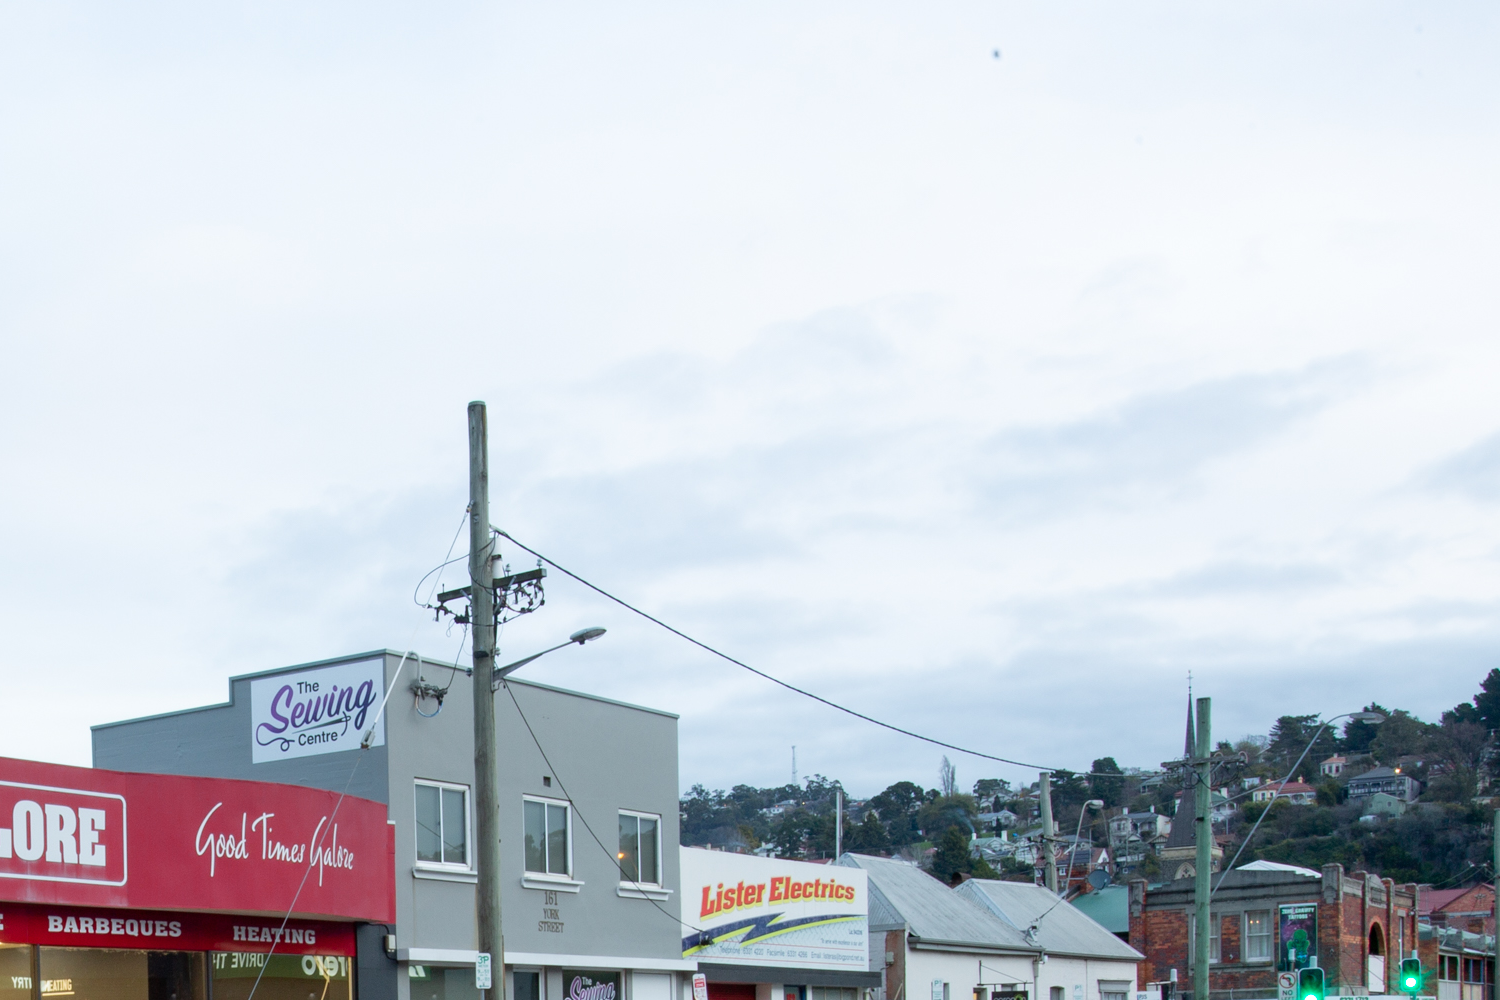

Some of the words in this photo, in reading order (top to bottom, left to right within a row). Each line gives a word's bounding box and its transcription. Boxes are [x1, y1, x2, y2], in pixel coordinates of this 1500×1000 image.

[297, 681, 319, 694] The
[257, 679, 376, 740] Sewing
[298, 731, 338, 746] Centre
[195, 802, 249, 877] Good
[252, 812, 306, 863] Times
[310, 816, 354, 887] Galore
[544, 891, 558, 905] 161
[700, 881, 765, 920] Lister
[769, 876, 855, 904] Electrics
[47, 915, 182, 938] BARBEQUES
[538, 921, 564, 933] STREET
[232, 925, 316, 944] HEATING
[477, 955, 490, 965] 3P
[582, 976, 592, 985] The
